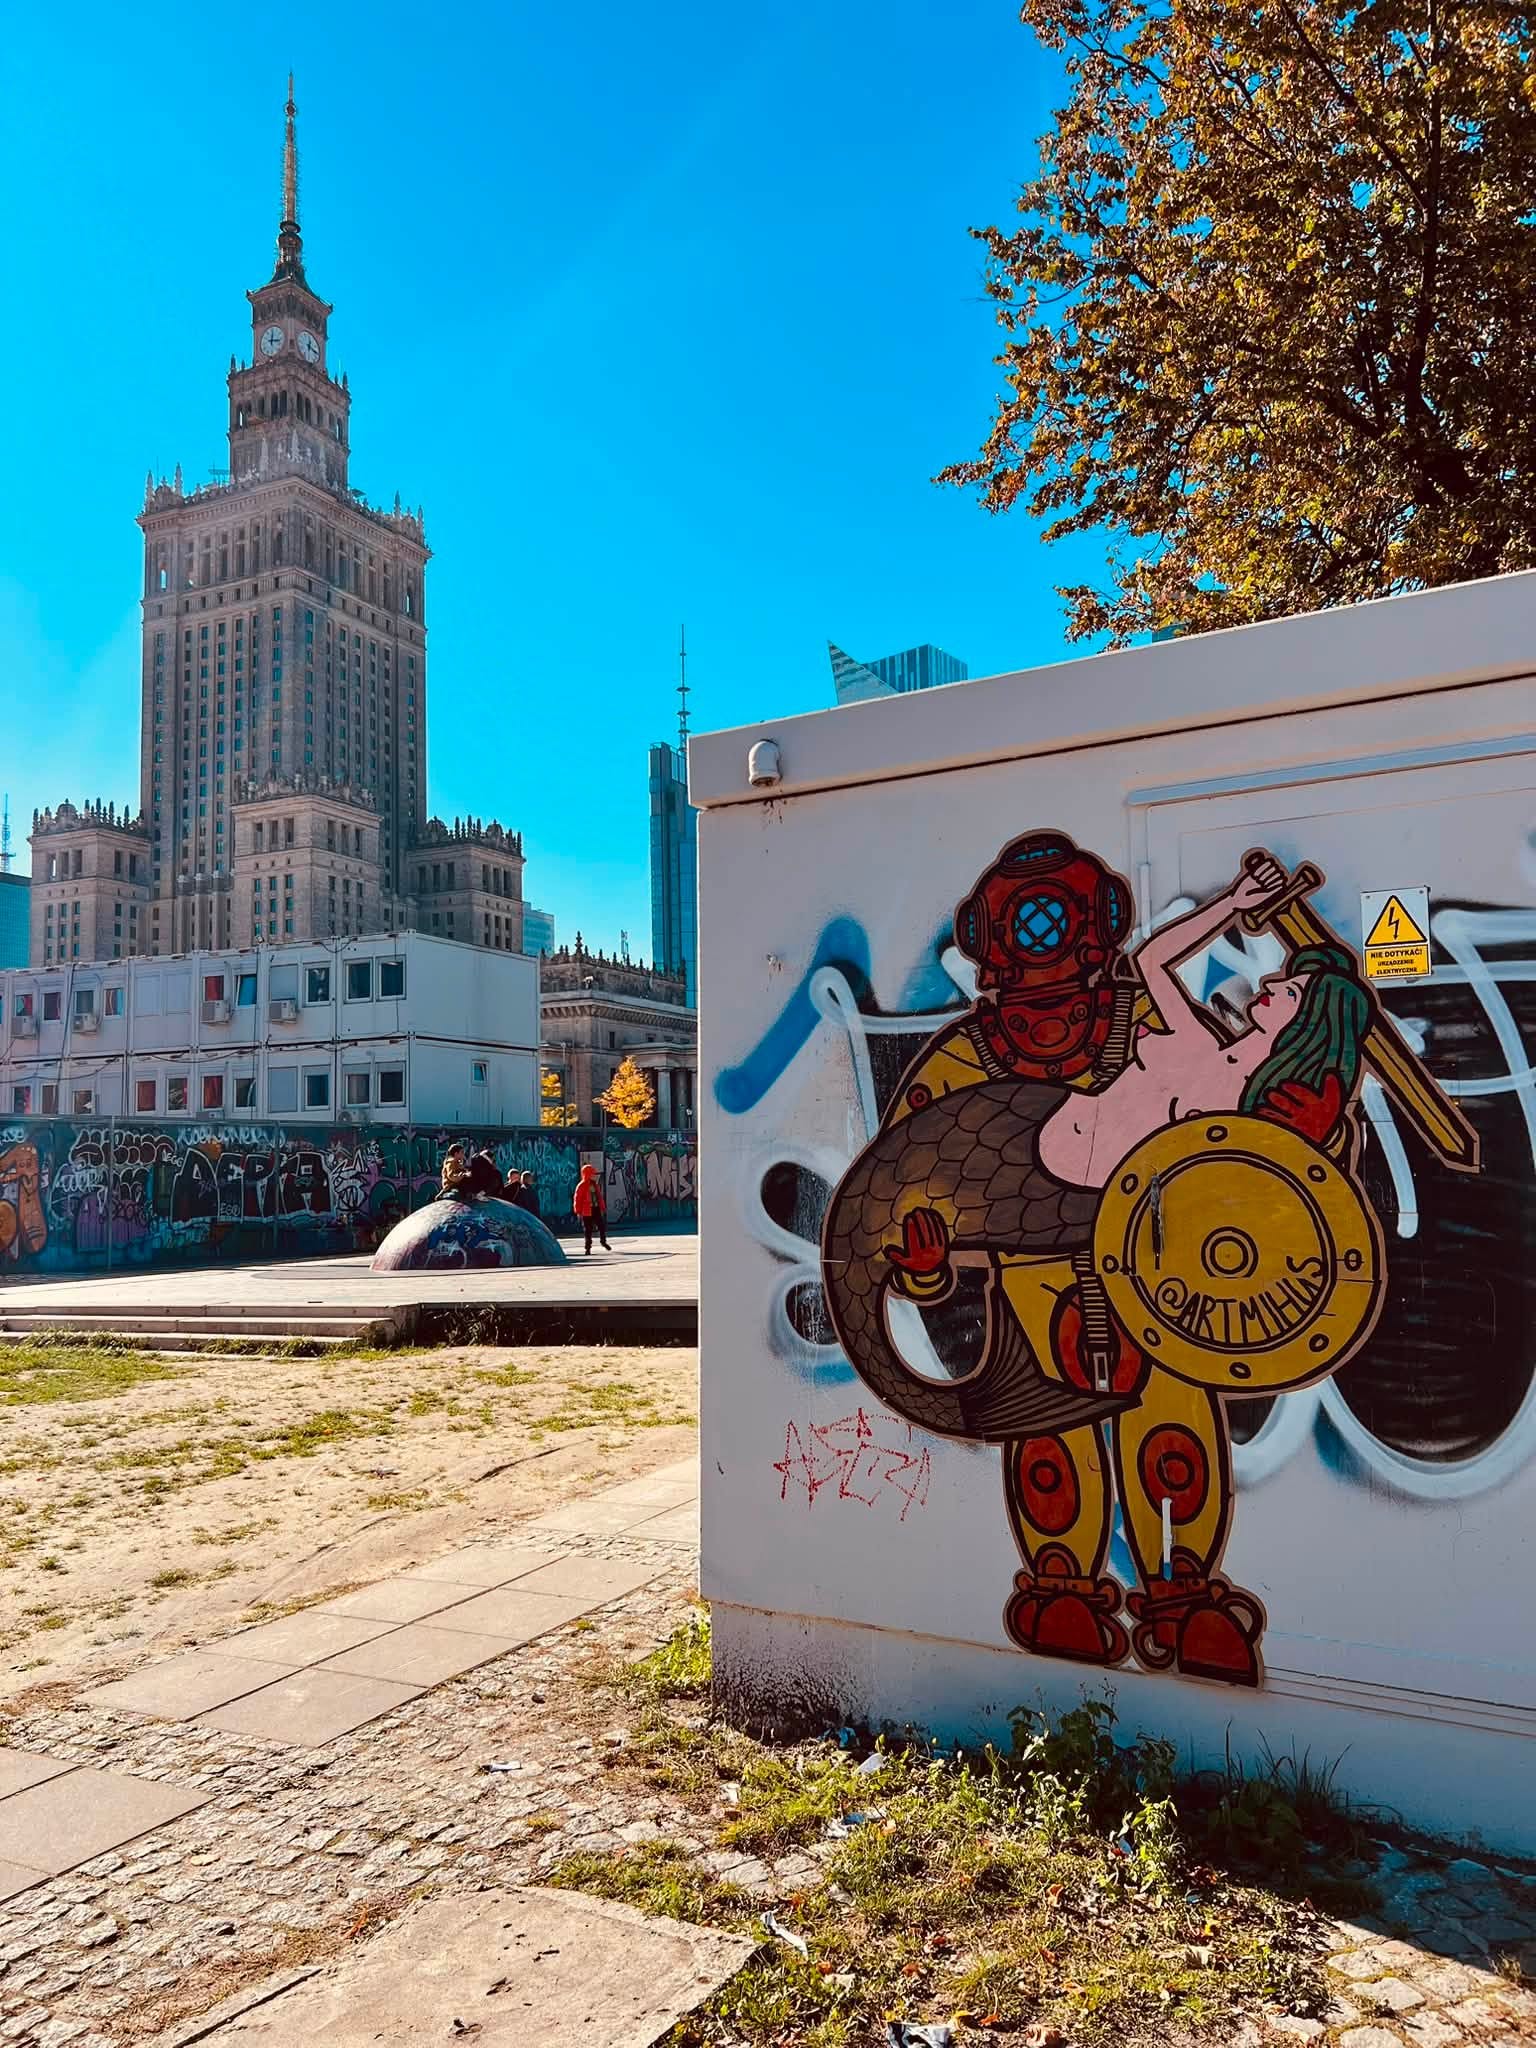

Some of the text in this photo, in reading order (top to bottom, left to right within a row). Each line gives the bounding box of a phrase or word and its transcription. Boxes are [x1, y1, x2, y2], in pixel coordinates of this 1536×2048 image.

[1370, 948, 1422, 959] NIE DOTYKAĆ!
[1376, 967, 1417, 975] ELEKTRYCZNE
